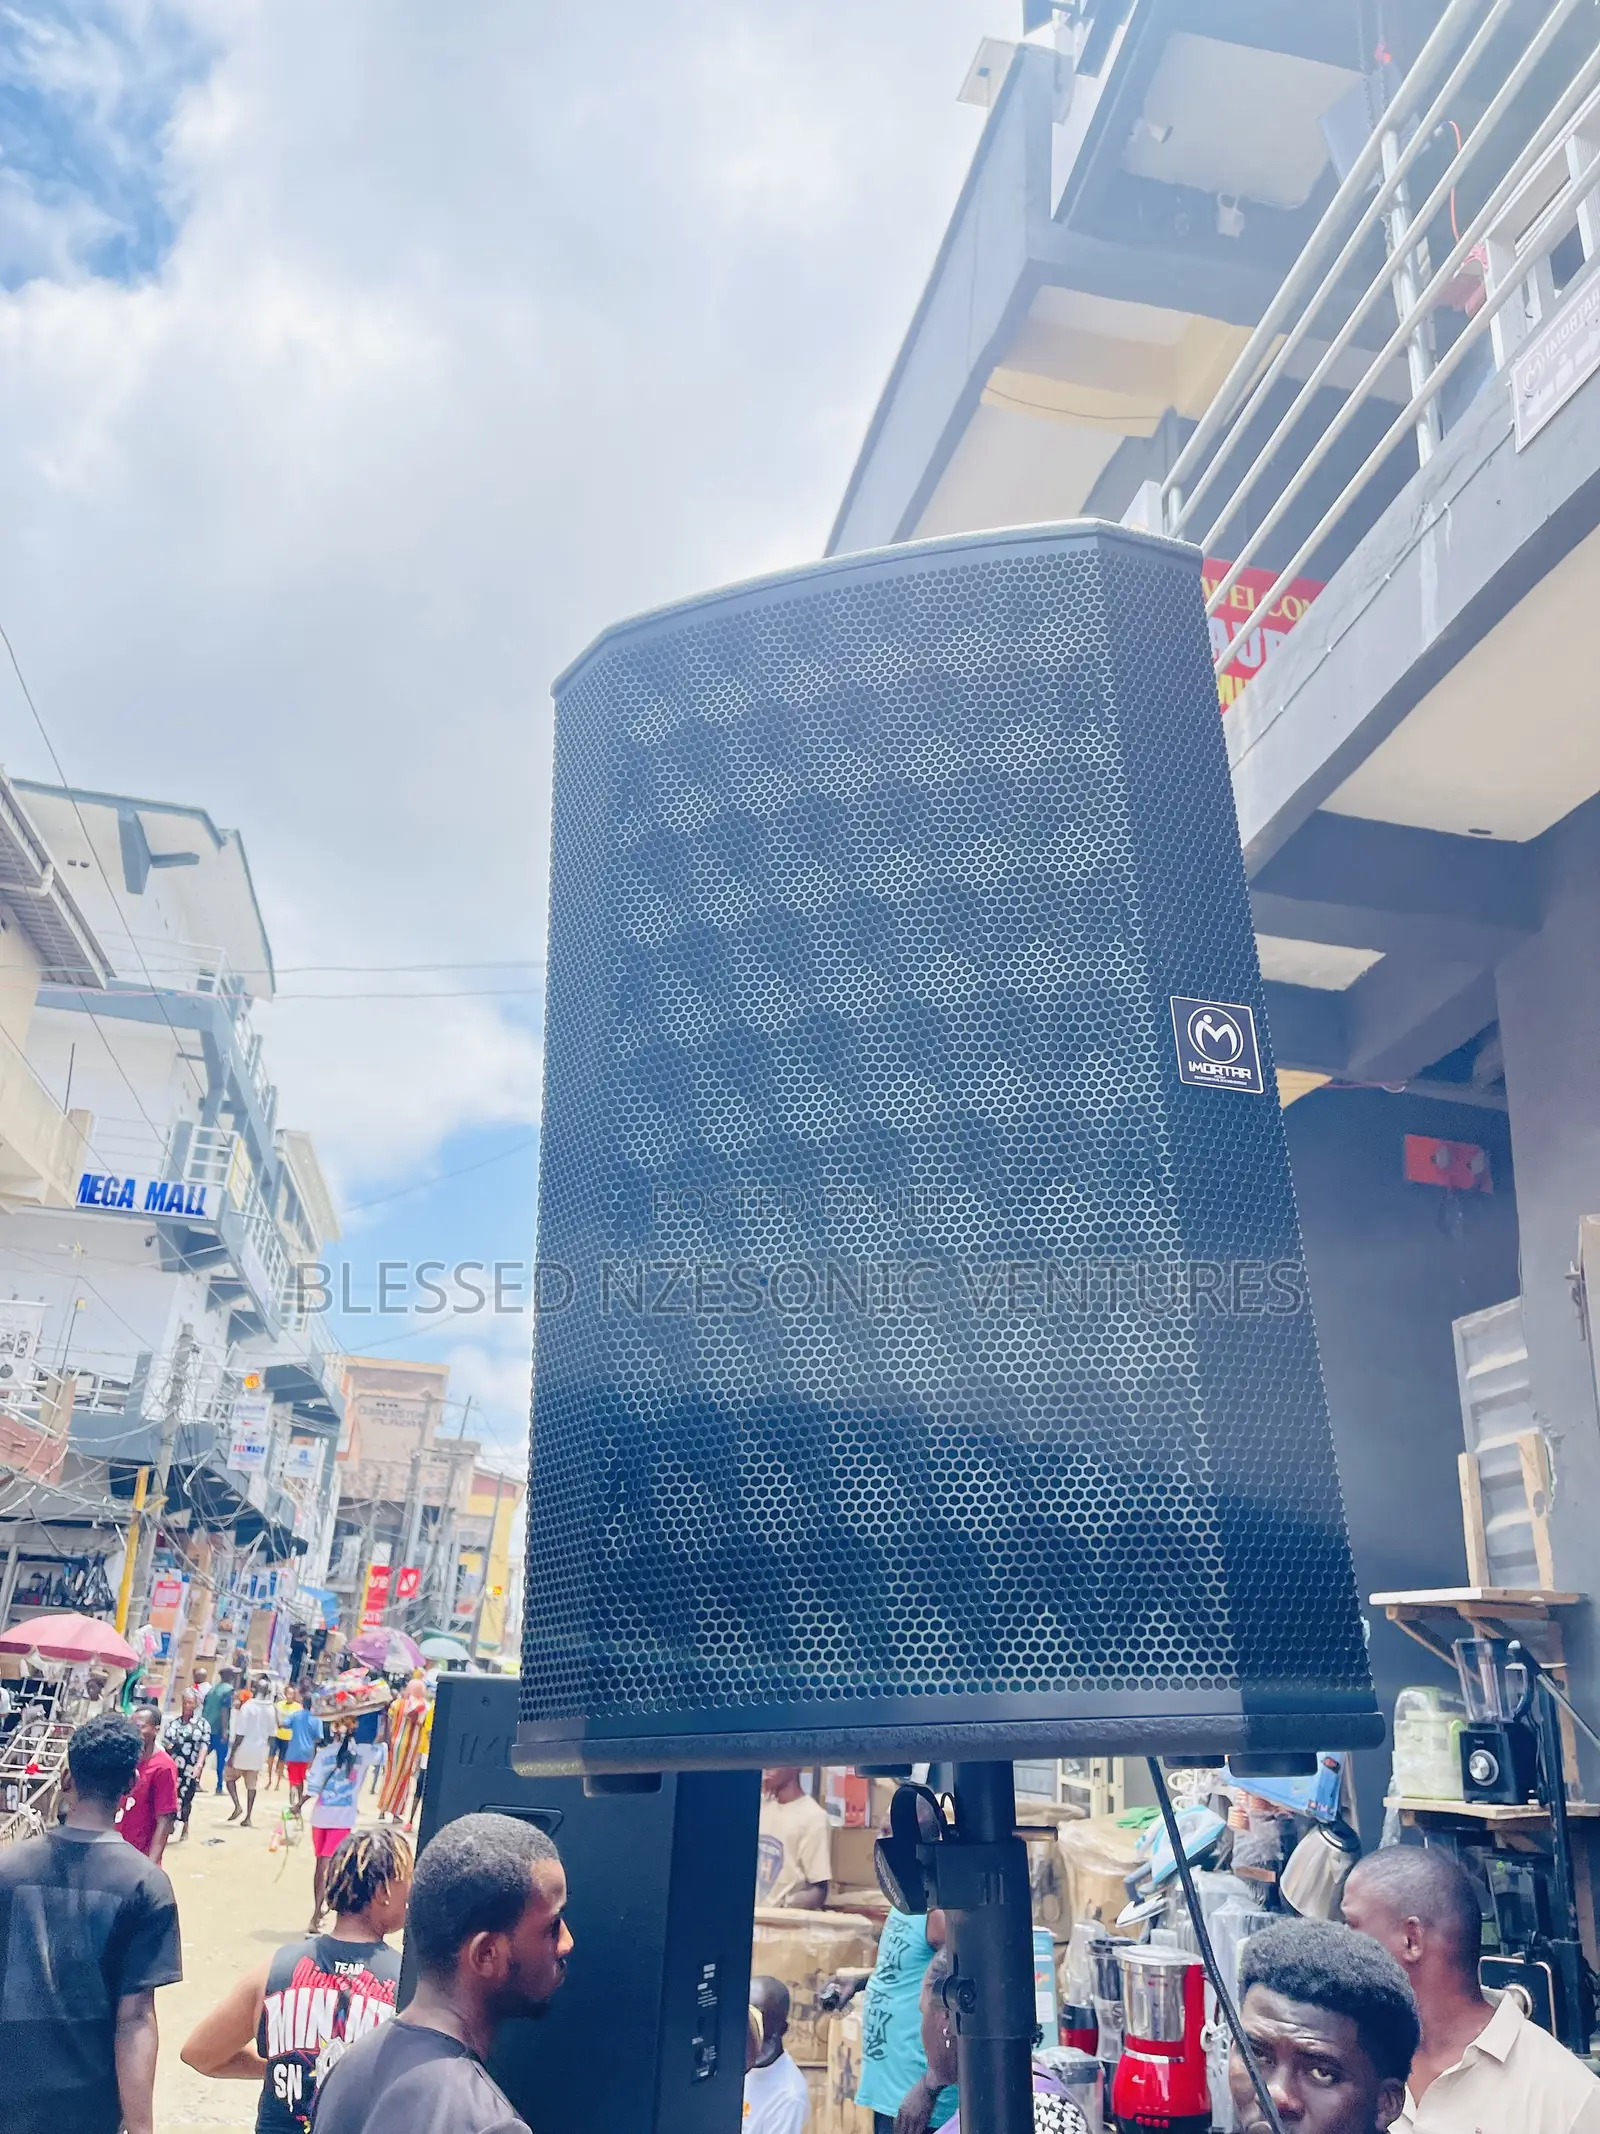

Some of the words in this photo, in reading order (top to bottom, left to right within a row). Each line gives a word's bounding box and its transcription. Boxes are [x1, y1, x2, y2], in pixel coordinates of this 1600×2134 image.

[1188, 1060, 1252, 1080] IMORTAR
[144, 1181, 207, 1216] MALL
[334, 1961, 365, 1975] TEAM
